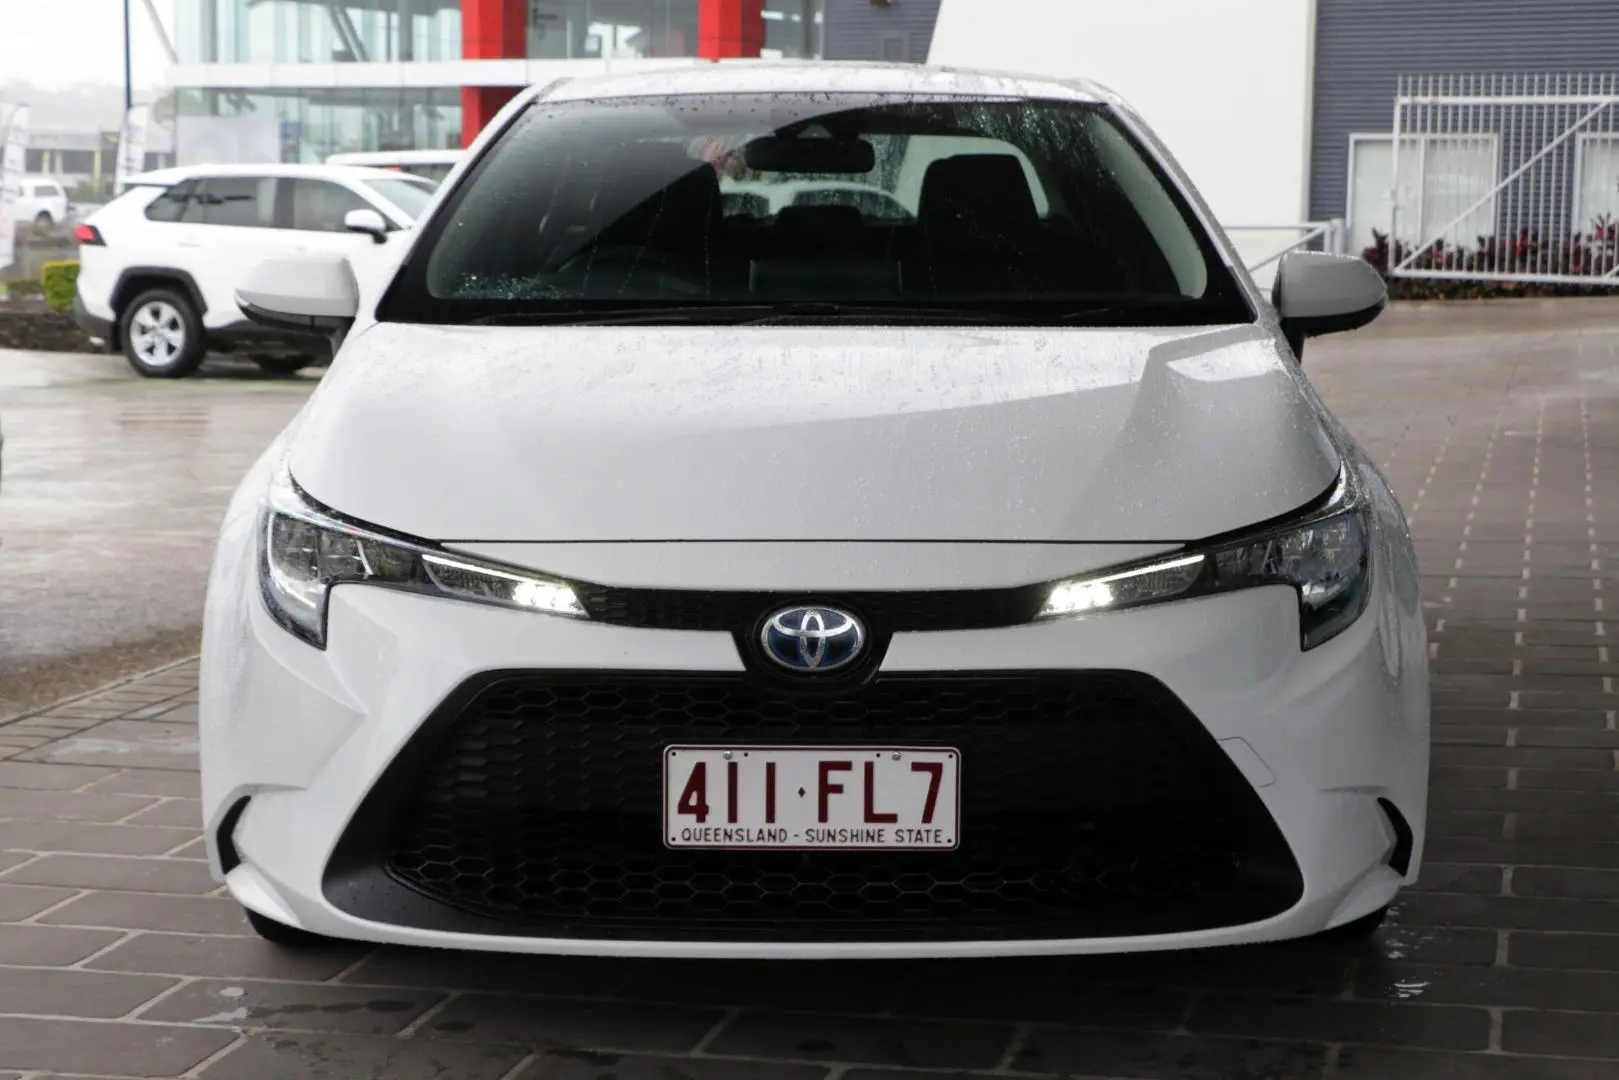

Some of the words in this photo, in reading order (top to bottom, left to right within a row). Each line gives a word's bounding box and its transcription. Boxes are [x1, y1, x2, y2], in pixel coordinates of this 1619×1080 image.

[681, 828, 788, 844] QUEENSLAND
[805, 828, 886, 844] SUNSHINE
[895, 829, 943, 844] STATE
